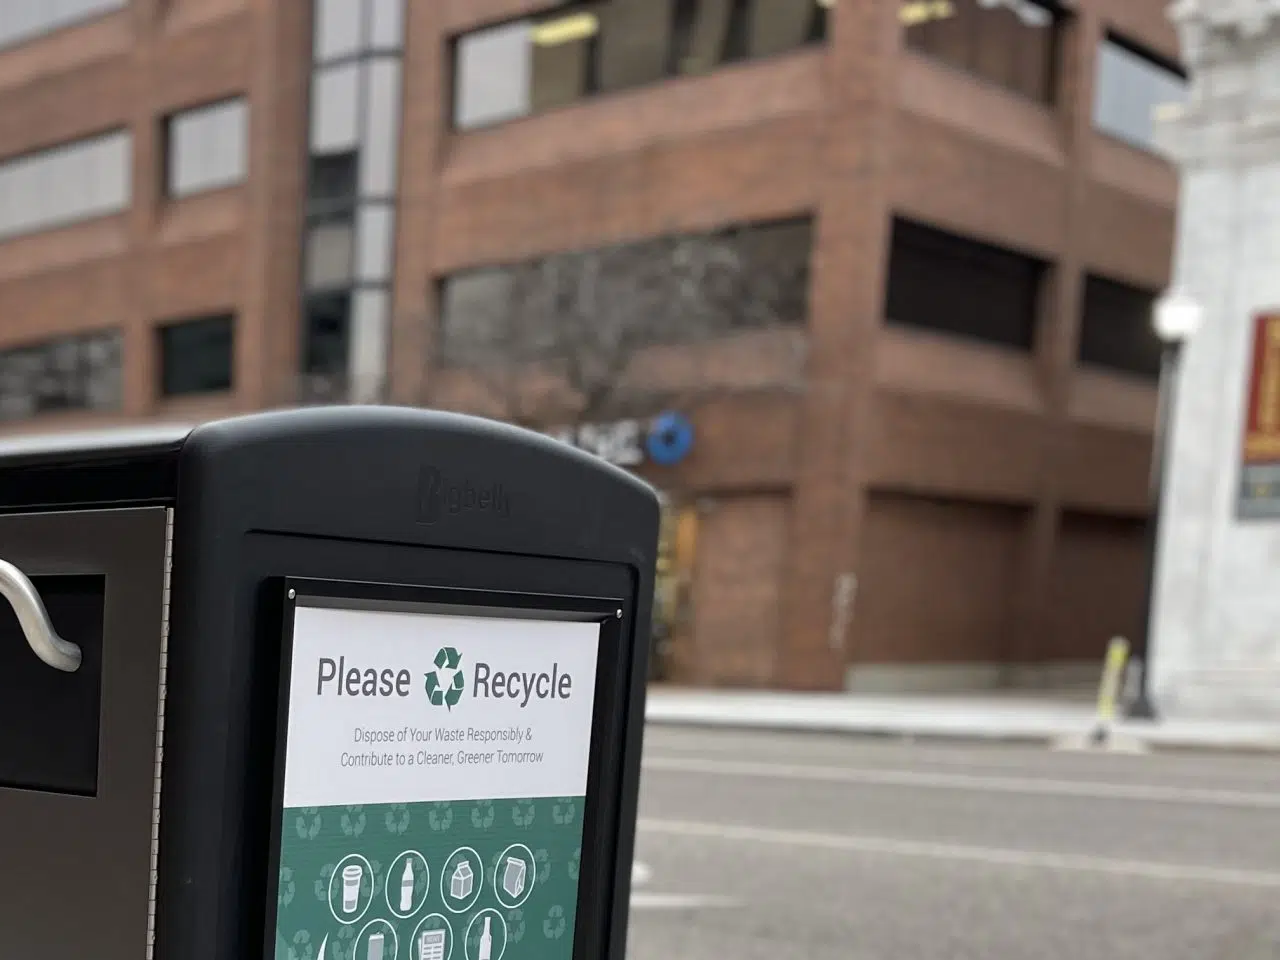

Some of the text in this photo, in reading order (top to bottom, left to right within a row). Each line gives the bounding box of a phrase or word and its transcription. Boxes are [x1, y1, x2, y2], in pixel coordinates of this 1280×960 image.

[316, 655, 572, 707] Please Recycle
[354, 726, 532, 744] Dispose of Your Waste Responsibly &
[341, 749, 544, 767] Contribute to a Cleaner, Greener Tomorrow
